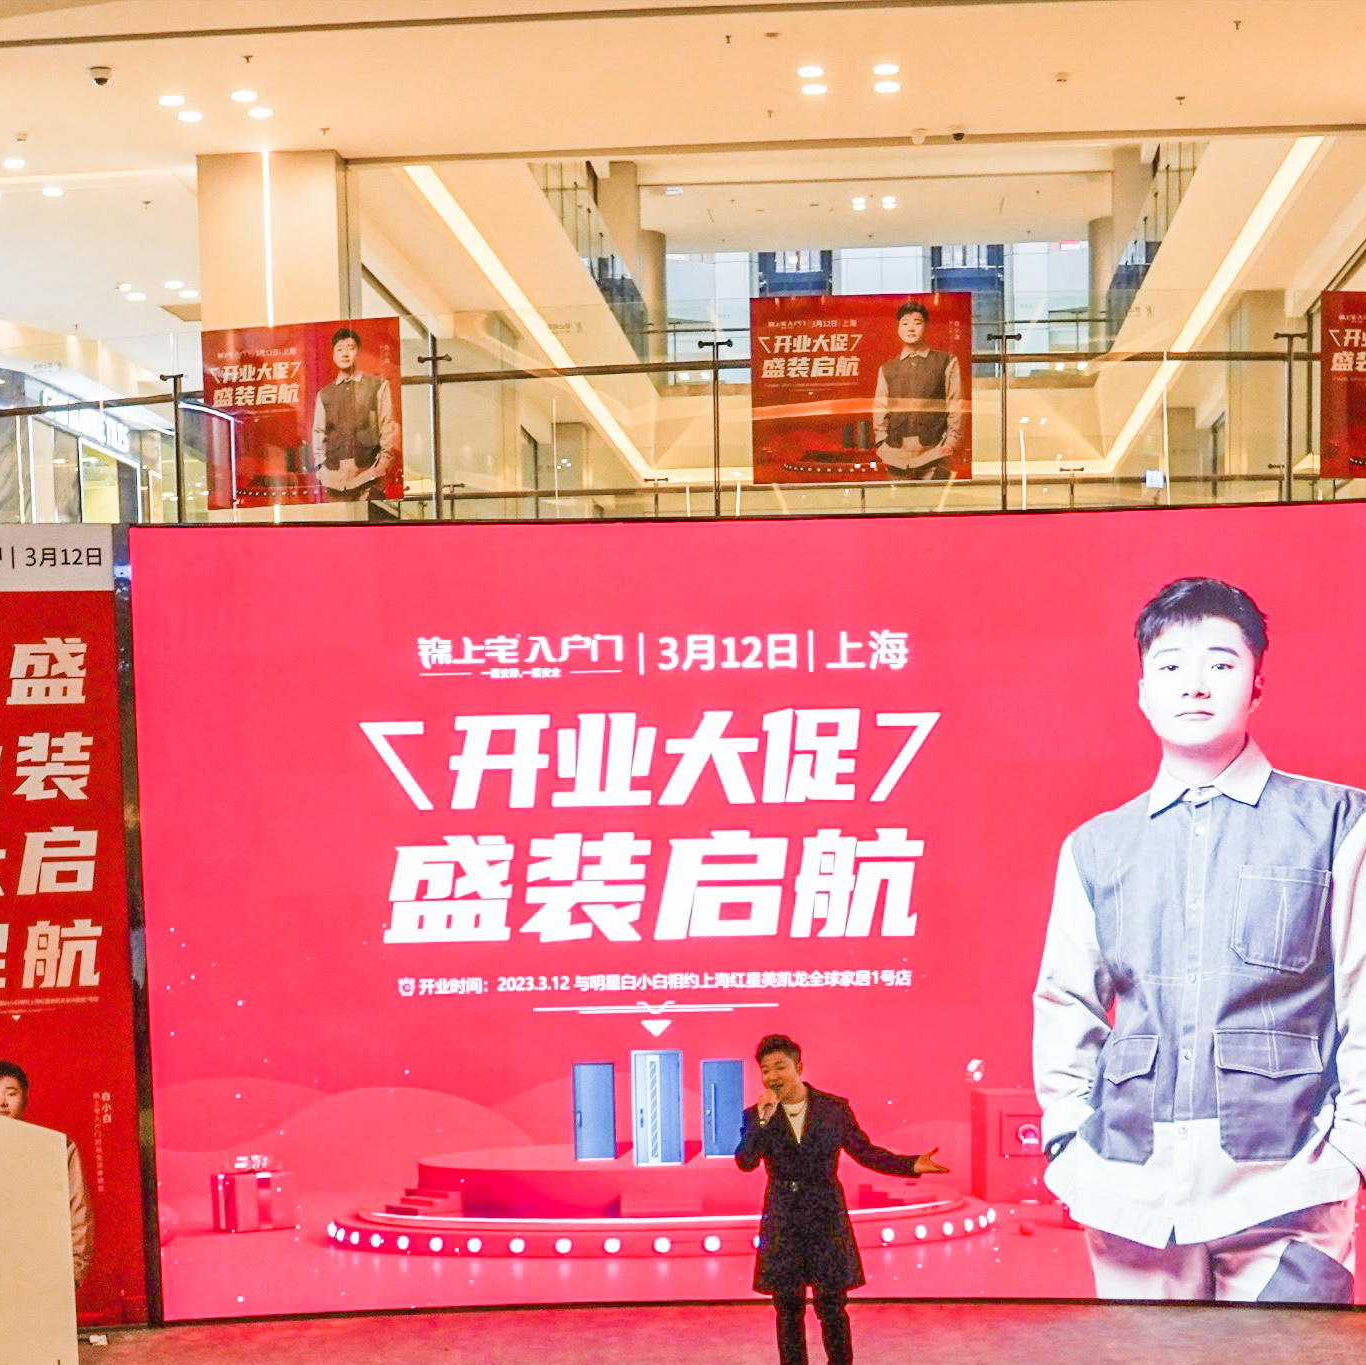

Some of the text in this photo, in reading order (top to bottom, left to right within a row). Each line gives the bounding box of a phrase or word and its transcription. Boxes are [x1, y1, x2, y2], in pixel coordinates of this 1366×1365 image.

[773, 334, 849, 353] 开业大促
[222, 362, 289, 384] 开业大促
[761, 355, 860, 379] 盛装启航
[213, 383, 300, 408] 盛装启航
[25, 547, 102, 567] 3月12日
[658, 632, 797, 671] 3月12日
[826, 629, 910, 670] 上海
[448, 707, 861, 809] 开业大促
[6, 637, 102, 989] 盛装启航
[383, 827, 924, 943] 盛装启航
[497, 974, 571, 992] 2023.3.12
